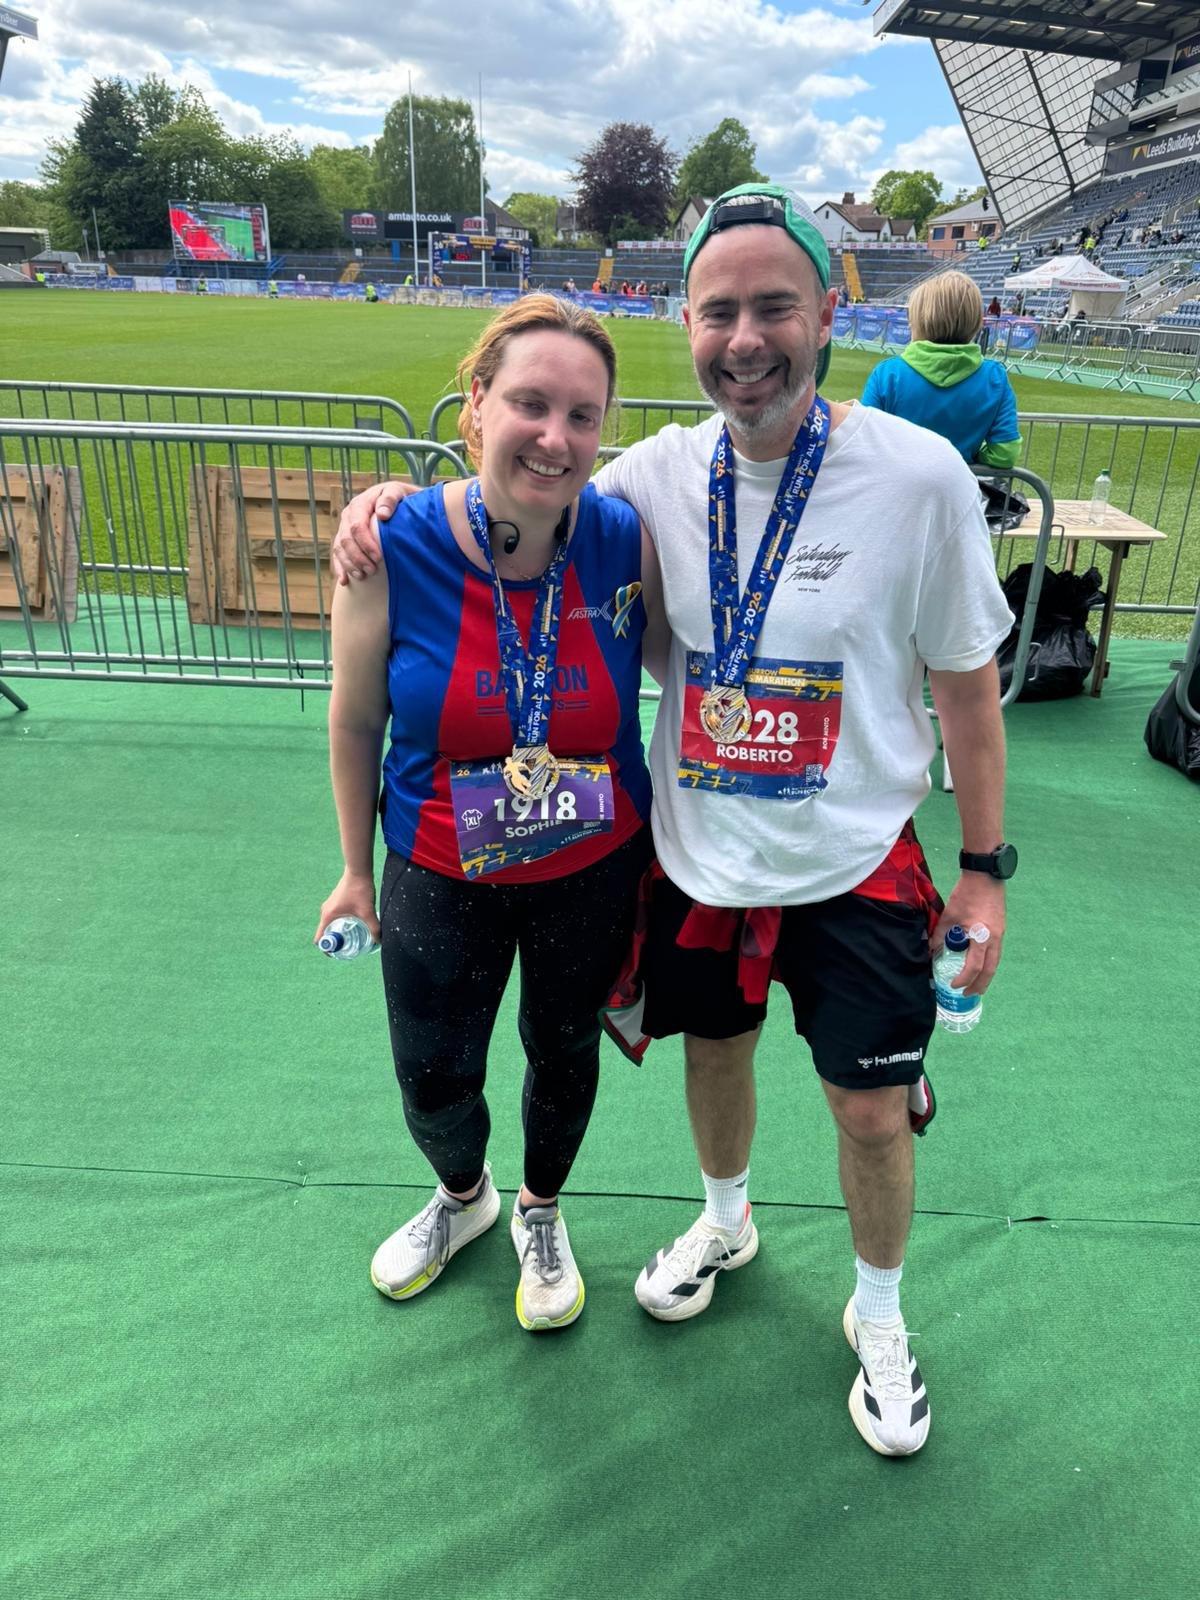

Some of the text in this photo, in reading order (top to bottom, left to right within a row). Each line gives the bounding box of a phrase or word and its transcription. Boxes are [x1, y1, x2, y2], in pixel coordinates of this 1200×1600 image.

[1147, 140, 1167, 158] Leeds
[1167, 132, 1195, 153] Building
[792, 477, 803, 495] RUN
[800, 458, 810, 476] FOR
[806, 443, 816, 458] ALL
[743, 592, 762, 627] 2026
[533, 655, 547, 688] 2026
[728, 663, 739, 681] RUN
[735, 648, 744, 663] FOR
[740, 633, 749, 648] ALL
[476, 664, 589, 698] BAON
[757, 676, 806, 688] MARATHON
[531, 696, 543, 743] RUN FOR ALL
[716, 743, 793, 763] ROBERTO
[468, 816, 478, 826] XL
[494, 791, 577, 821] 1918
[875, 1047, 923, 1067] hummel
